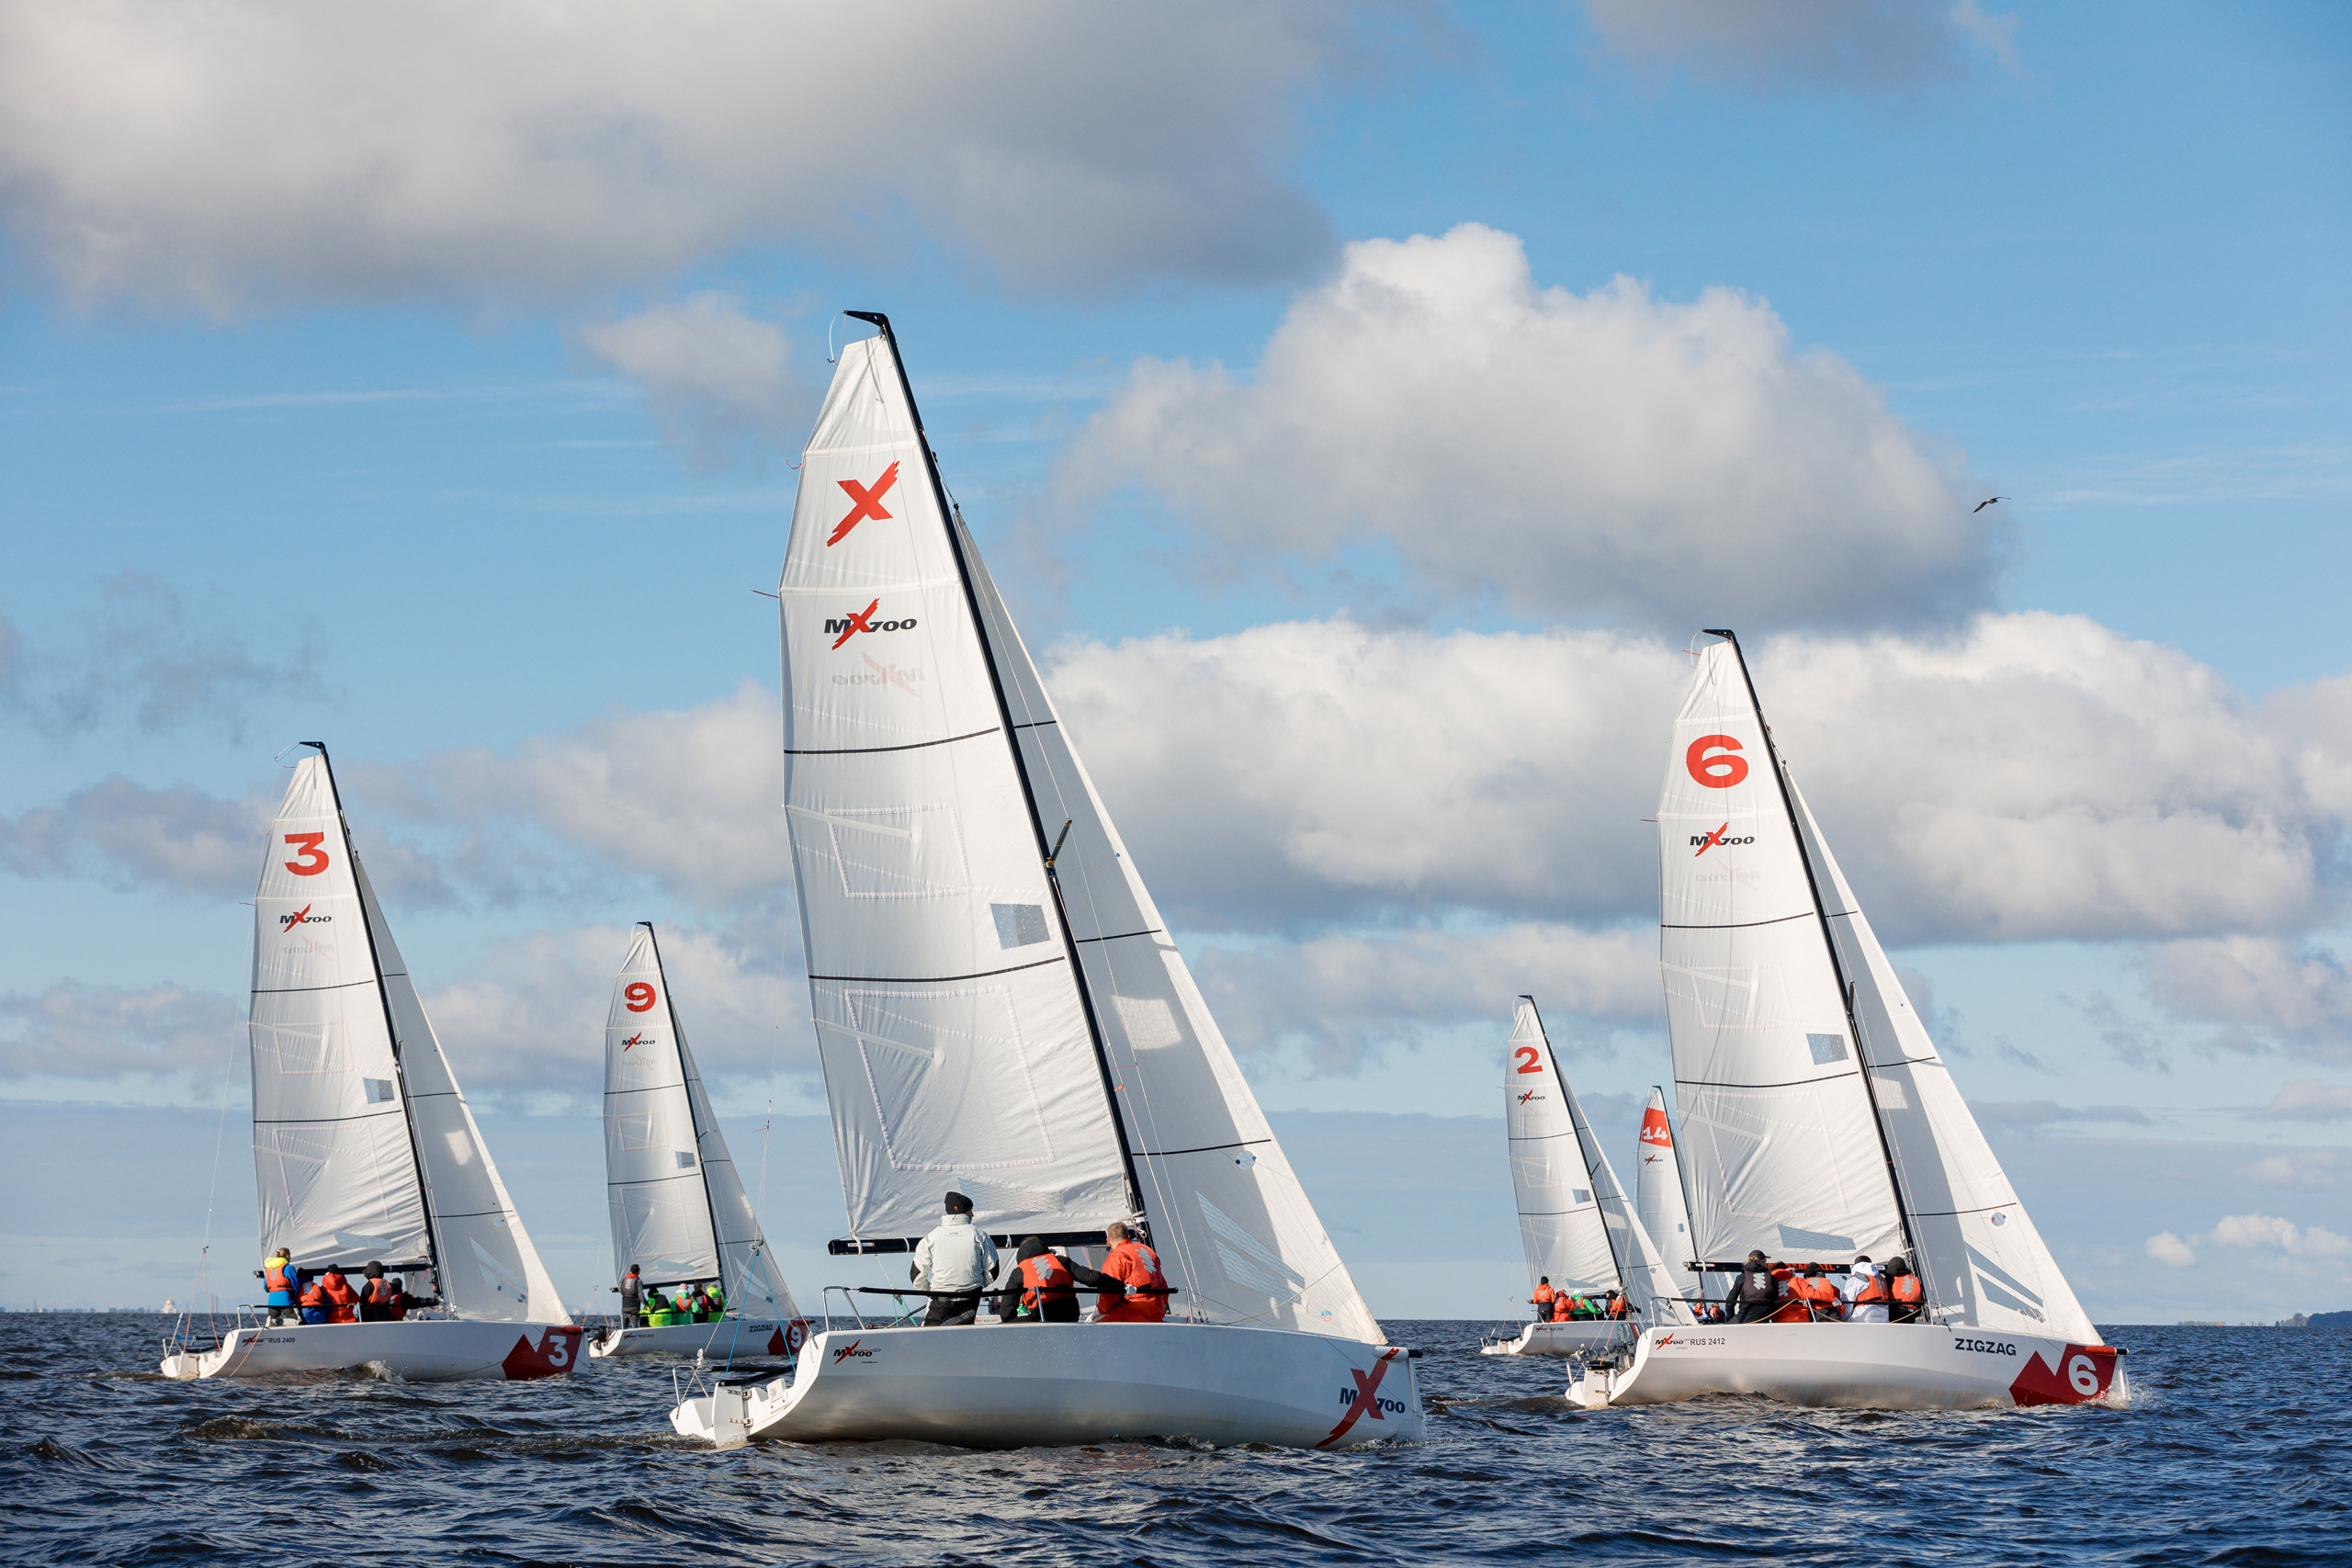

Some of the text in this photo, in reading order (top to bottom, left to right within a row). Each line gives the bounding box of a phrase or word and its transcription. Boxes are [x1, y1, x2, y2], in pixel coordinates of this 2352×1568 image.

[824, 598, 917, 650] MX700
[1686, 734, 1749, 788] 6
[1690, 821, 1755, 857] MX700
[284, 831, 330, 876] 3
[279, 904, 332, 933] MX700
[625, 982, 656, 1012] 9
[621, 1031, 656, 1052] MX700
[1514, 1046, 1544, 1074] 2
[1517, 1089, 1545, 1106] MX700
[1643, 1126, 1668, 1141] 14
[548, 1335, 569, 1367] 3
[790, 1326, 802, 1348] 9
[1655, 1332, 1684, 1350] MX700
[1955, 1337, 2017, 1357] ZIGZAG
[832, 1338, 873, 1365] MX700
[2068, 1354, 2099, 1395] 6
